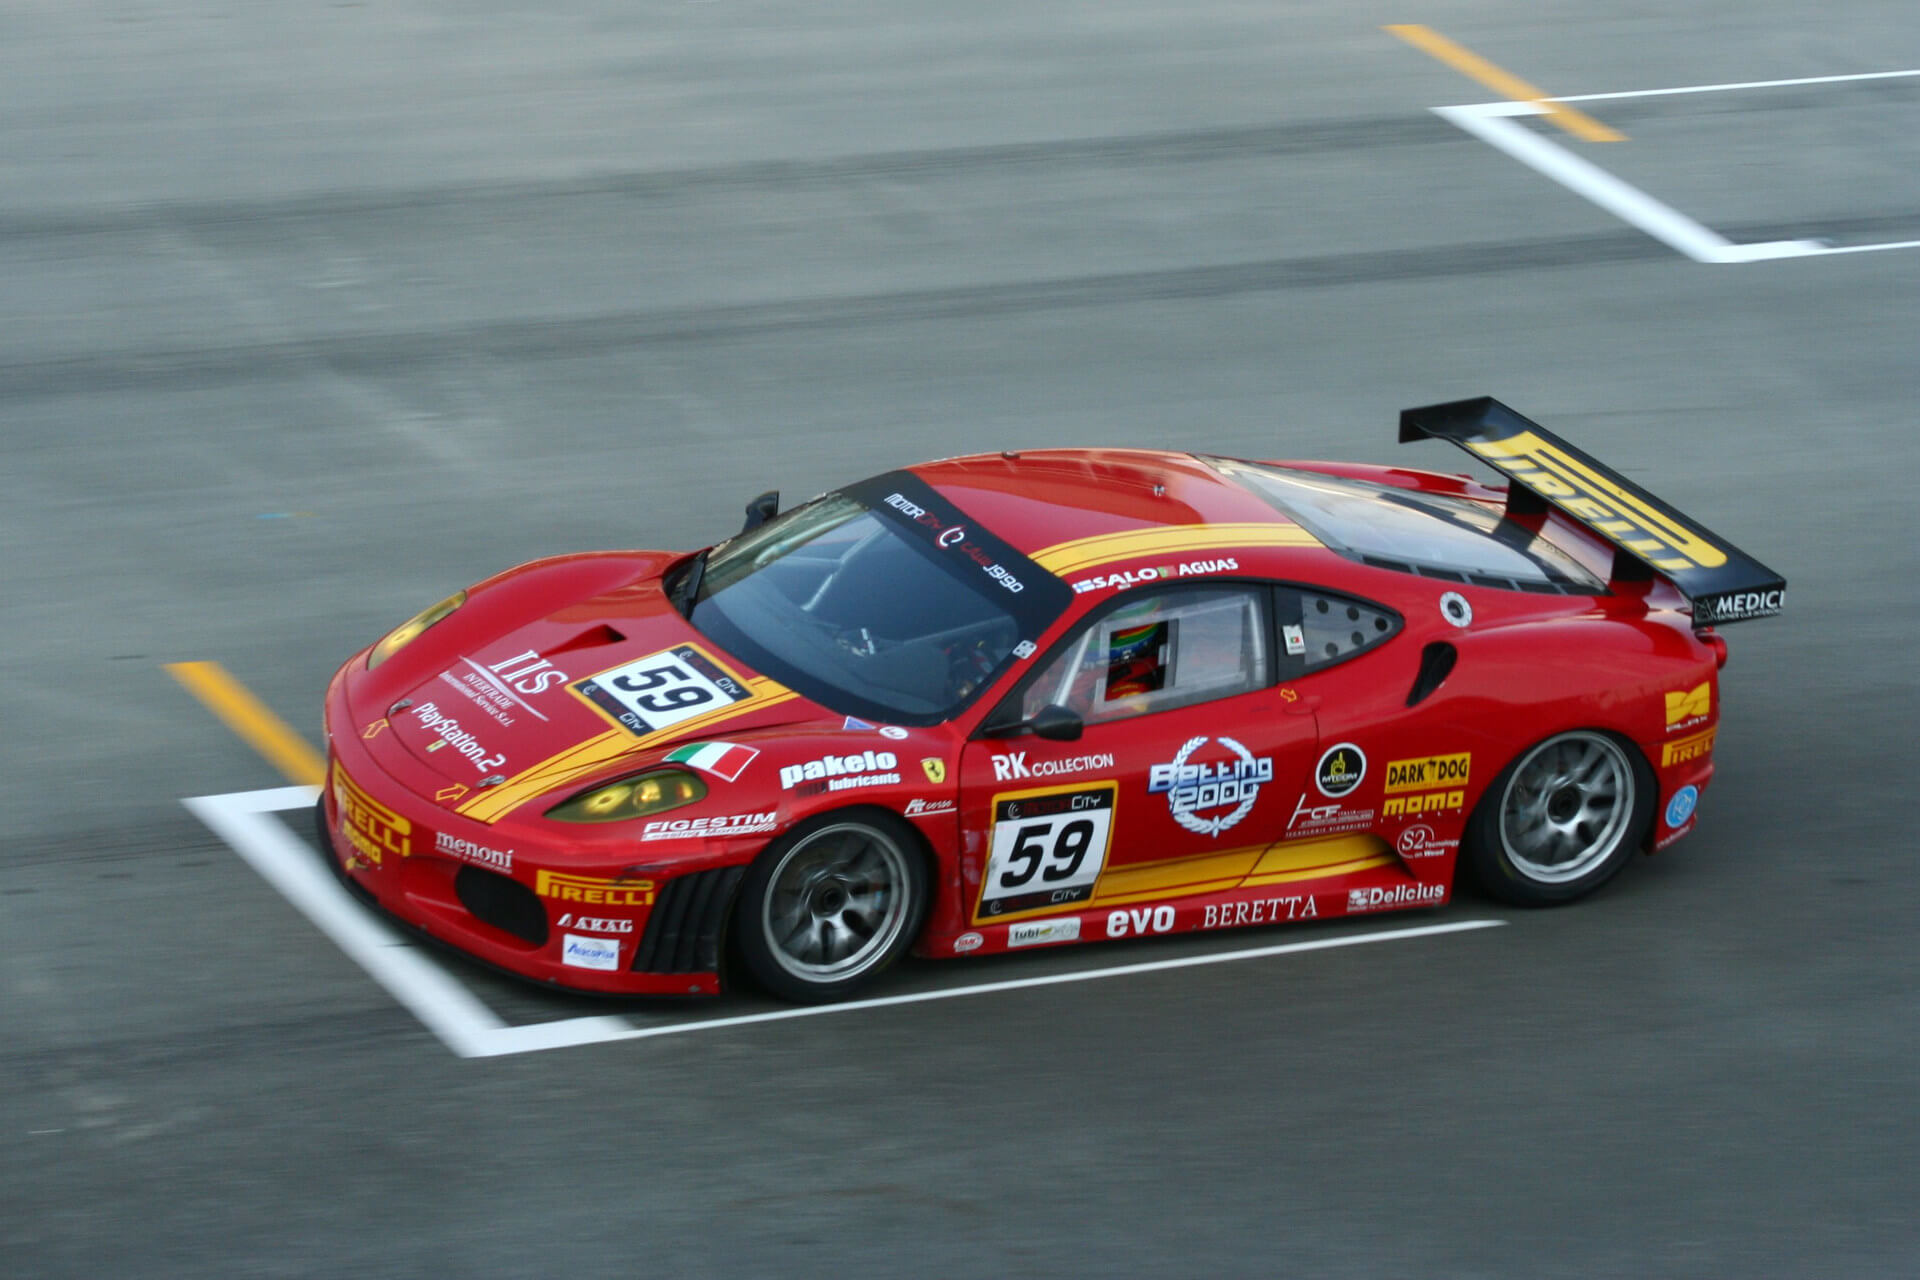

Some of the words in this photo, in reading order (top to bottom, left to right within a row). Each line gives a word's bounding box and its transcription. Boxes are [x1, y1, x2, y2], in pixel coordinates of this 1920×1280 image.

[1464, 430, 1728, 571] PIRELLI
[1093, 568, 1158, 588] SALO
[1178, 558, 1239, 576] AGUAS
[1716, 590, 1785, 613] MEDICI
[612, 665, 714, 712] 59
[1661, 725, 1716, 768] PIREL
[779, 751, 898, 790] pakelo
[828, 772, 901, 792] lubricants
[991, 752, 1031, 782] RK
[1031, 753, 1114, 778] COLLECTION
[1148, 757, 1273, 792] Betting
[1388, 764, 1425, 786] DARK
[1438, 757, 1468, 780] DOG
[1171, 779, 1258, 815] 2000
[643, 811, 777, 833] FIGESTIM
[435, 830, 514, 868] menoni
[1000, 819, 1095, 889] 59
[1401, 829, 1426, 851] S2
[535, 869, 655, 906] PIRELLI
[1368, 881, 1445, 906] Delicius
[1106, 906, 1176, 938] evo
[1203, 894, 1318, 928] BERETTA
